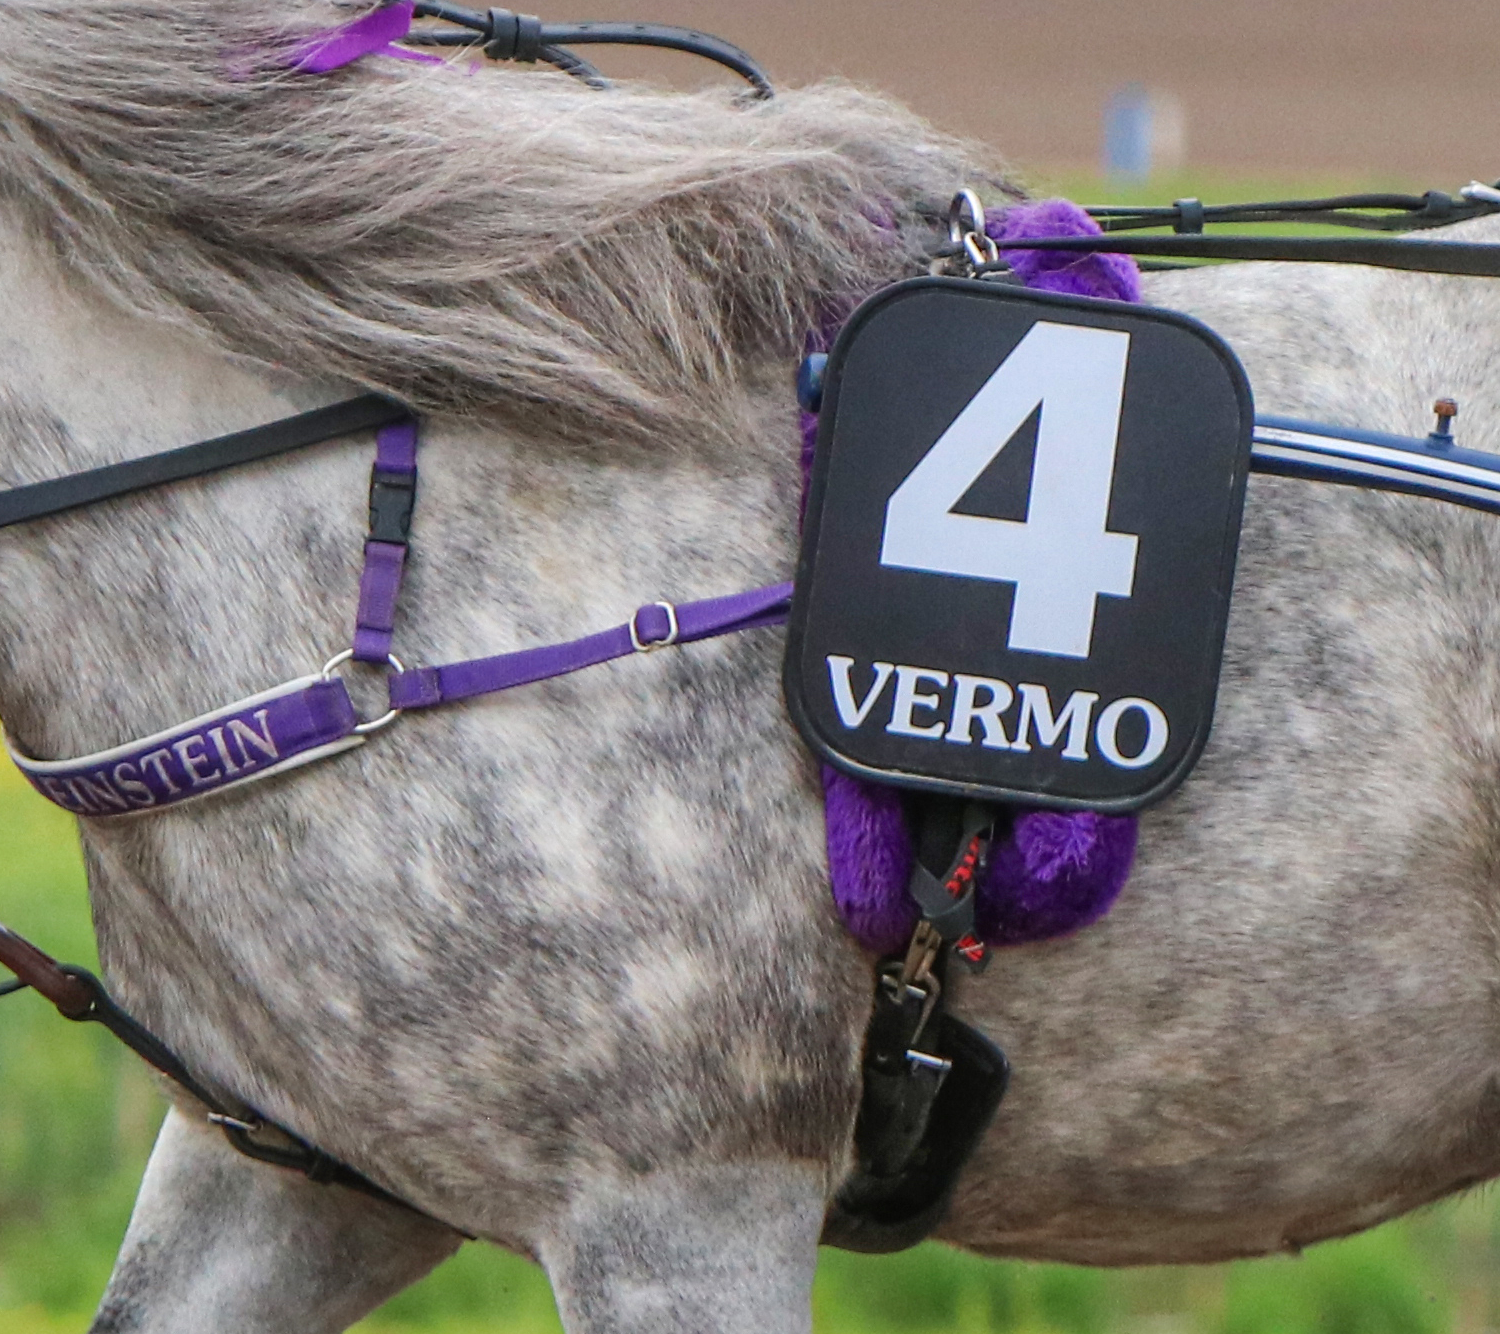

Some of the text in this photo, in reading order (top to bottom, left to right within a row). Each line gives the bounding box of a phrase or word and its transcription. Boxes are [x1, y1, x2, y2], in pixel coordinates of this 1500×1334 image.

[880, 320, 1139, 658] 4
[40, 709, 279, 813] EINSTEIN
[825, 654, 1169, 769] VERMO
